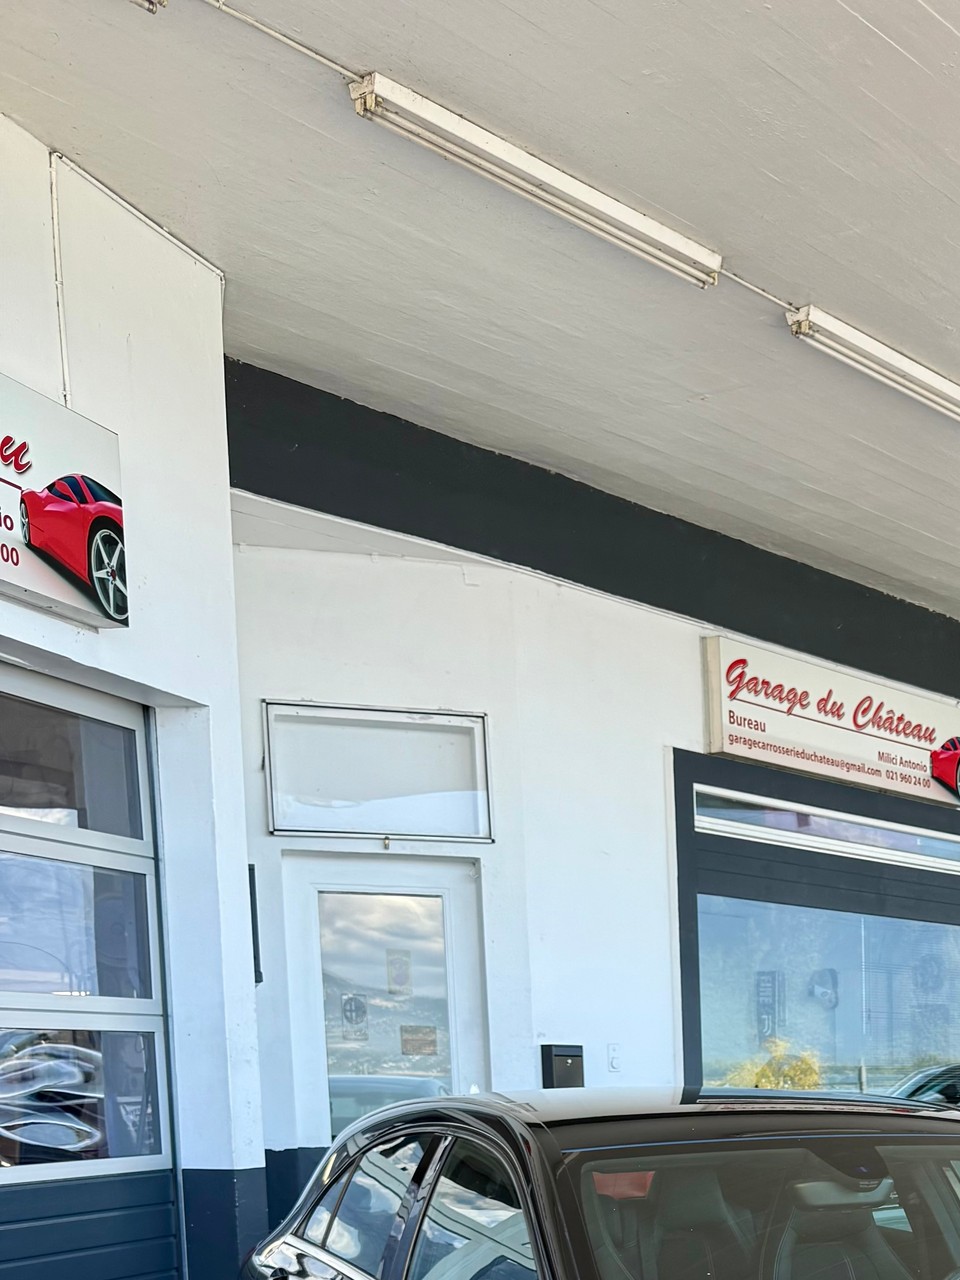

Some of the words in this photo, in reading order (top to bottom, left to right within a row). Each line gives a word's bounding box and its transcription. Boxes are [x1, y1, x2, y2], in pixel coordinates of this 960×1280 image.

[725, 658, 810, 716] Garage
[817, 689, 845, 721] du
[852, 695, 937, 744] Château
[728, 710, 766, 733] Bureau
[877, 751, 898, 766] Milici
[899, 757, 927, 773] Antonio
[885, 770, 898, 782] 021
[899, 772, 912, 785] 960
[912, 775, 922, 787] 24
[922, 778, 931, 789] 00
